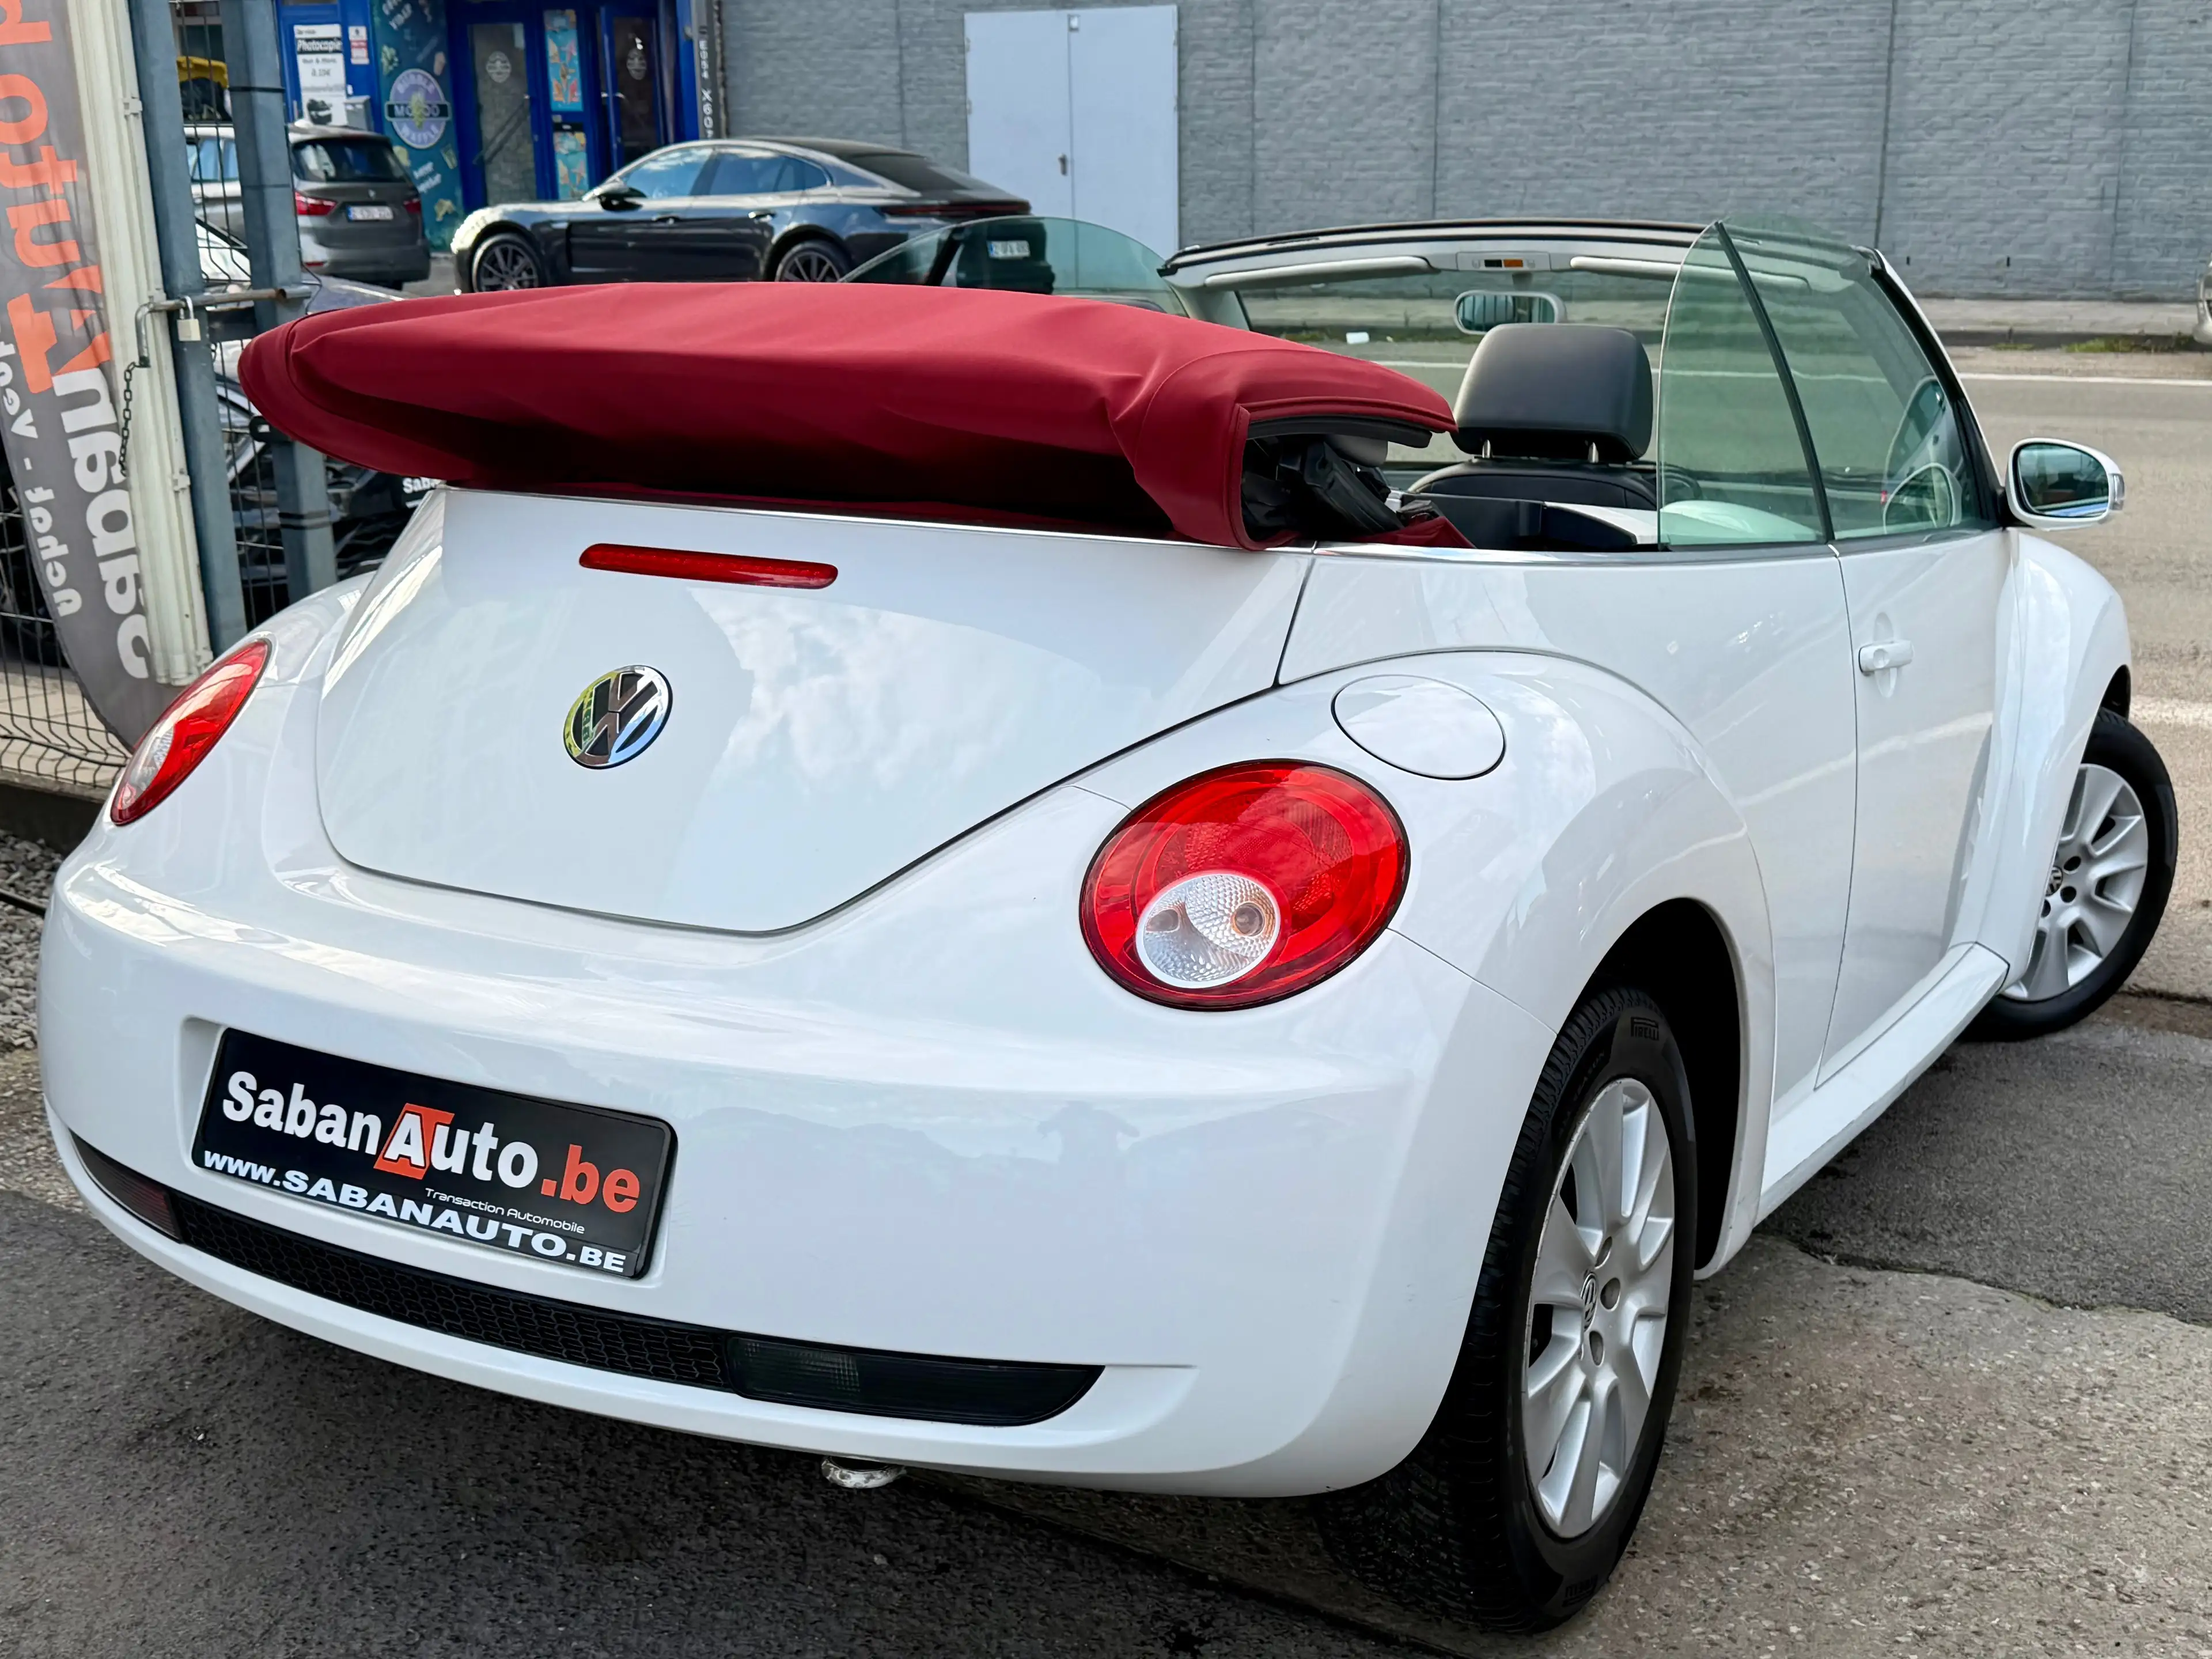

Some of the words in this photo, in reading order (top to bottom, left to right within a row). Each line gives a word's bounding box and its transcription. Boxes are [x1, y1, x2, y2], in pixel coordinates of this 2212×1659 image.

[204, 1150, 626, 1273] www.SABANAUTO.BE
[425, 1187, 505, 1216] Transaction
[507, 1209, 585, 1234] Automobile
